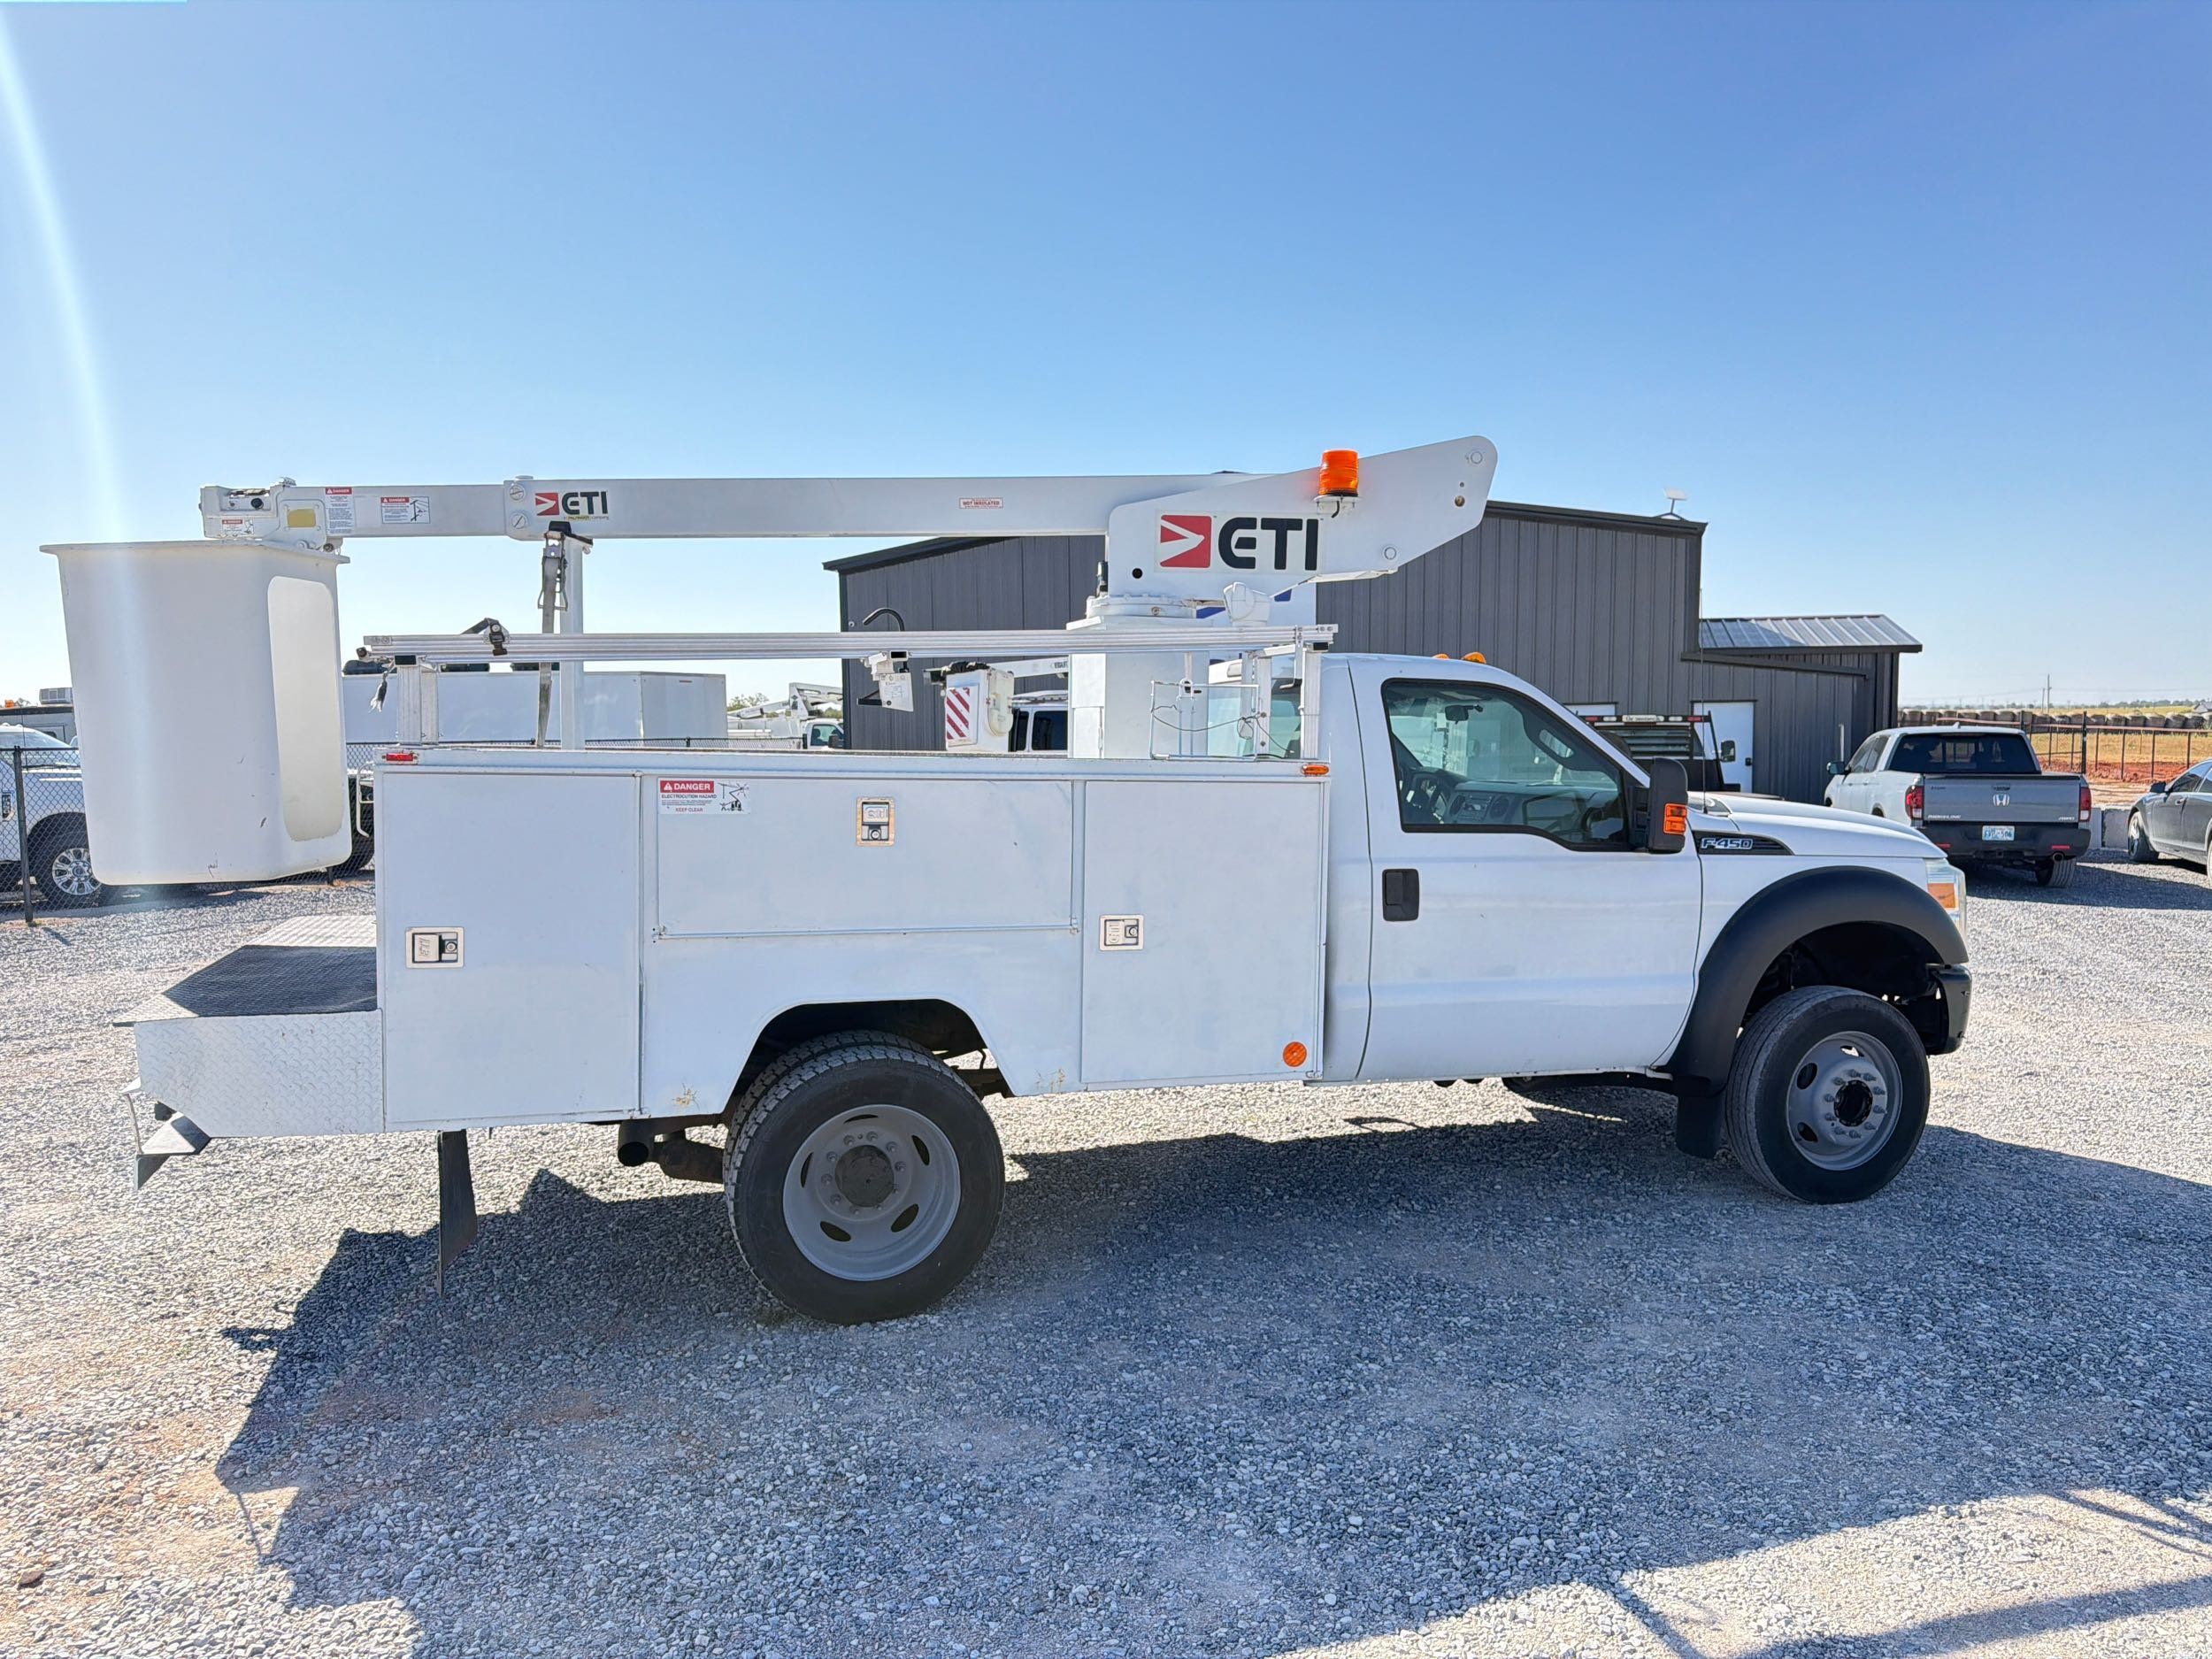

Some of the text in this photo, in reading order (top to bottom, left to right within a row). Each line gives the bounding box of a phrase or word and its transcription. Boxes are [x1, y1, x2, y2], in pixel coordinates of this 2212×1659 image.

[561, 491, 608, 515] ETI
[1218, 517, 1318, 571] ETI
[1701, 838, 1754, 849] F-450
